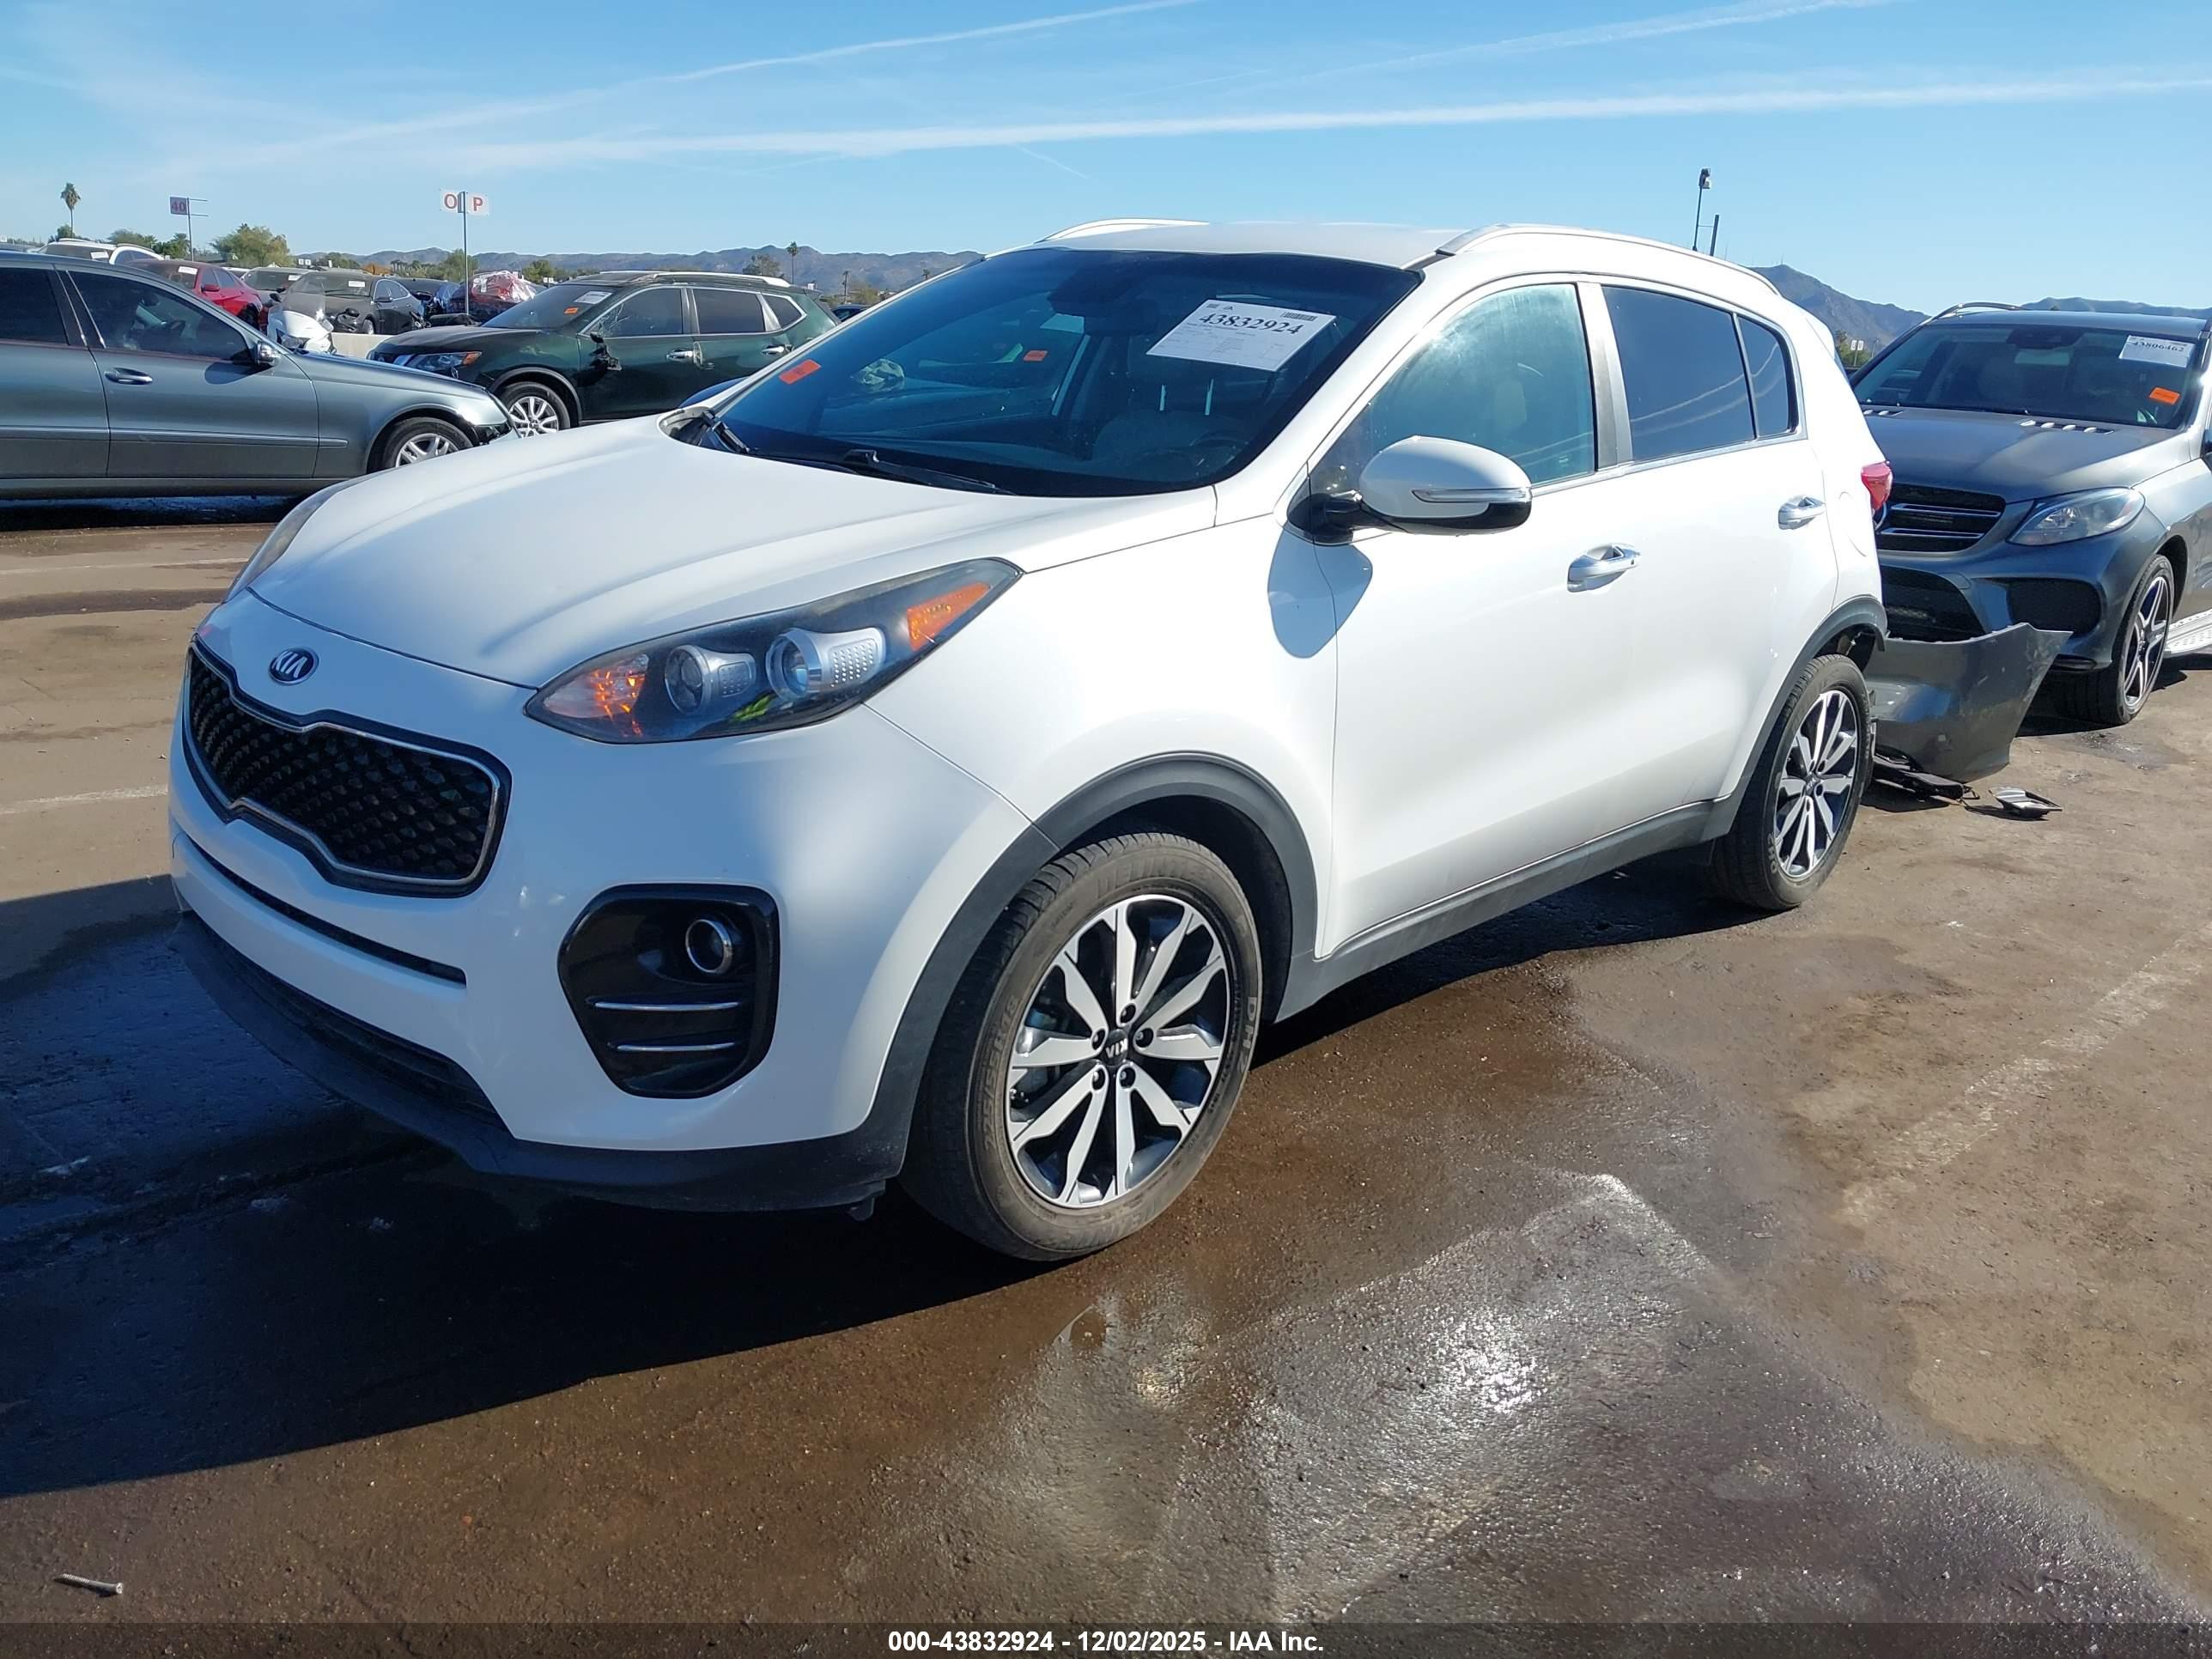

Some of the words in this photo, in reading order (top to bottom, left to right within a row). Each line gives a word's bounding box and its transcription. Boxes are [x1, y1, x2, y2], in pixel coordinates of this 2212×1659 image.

[444, 194, 457, 209] O
[473, 197, 483, 211] P
[1199, 313, 1304, 335] 43832924
[1106, 1037, 1128, 1059] KIA
